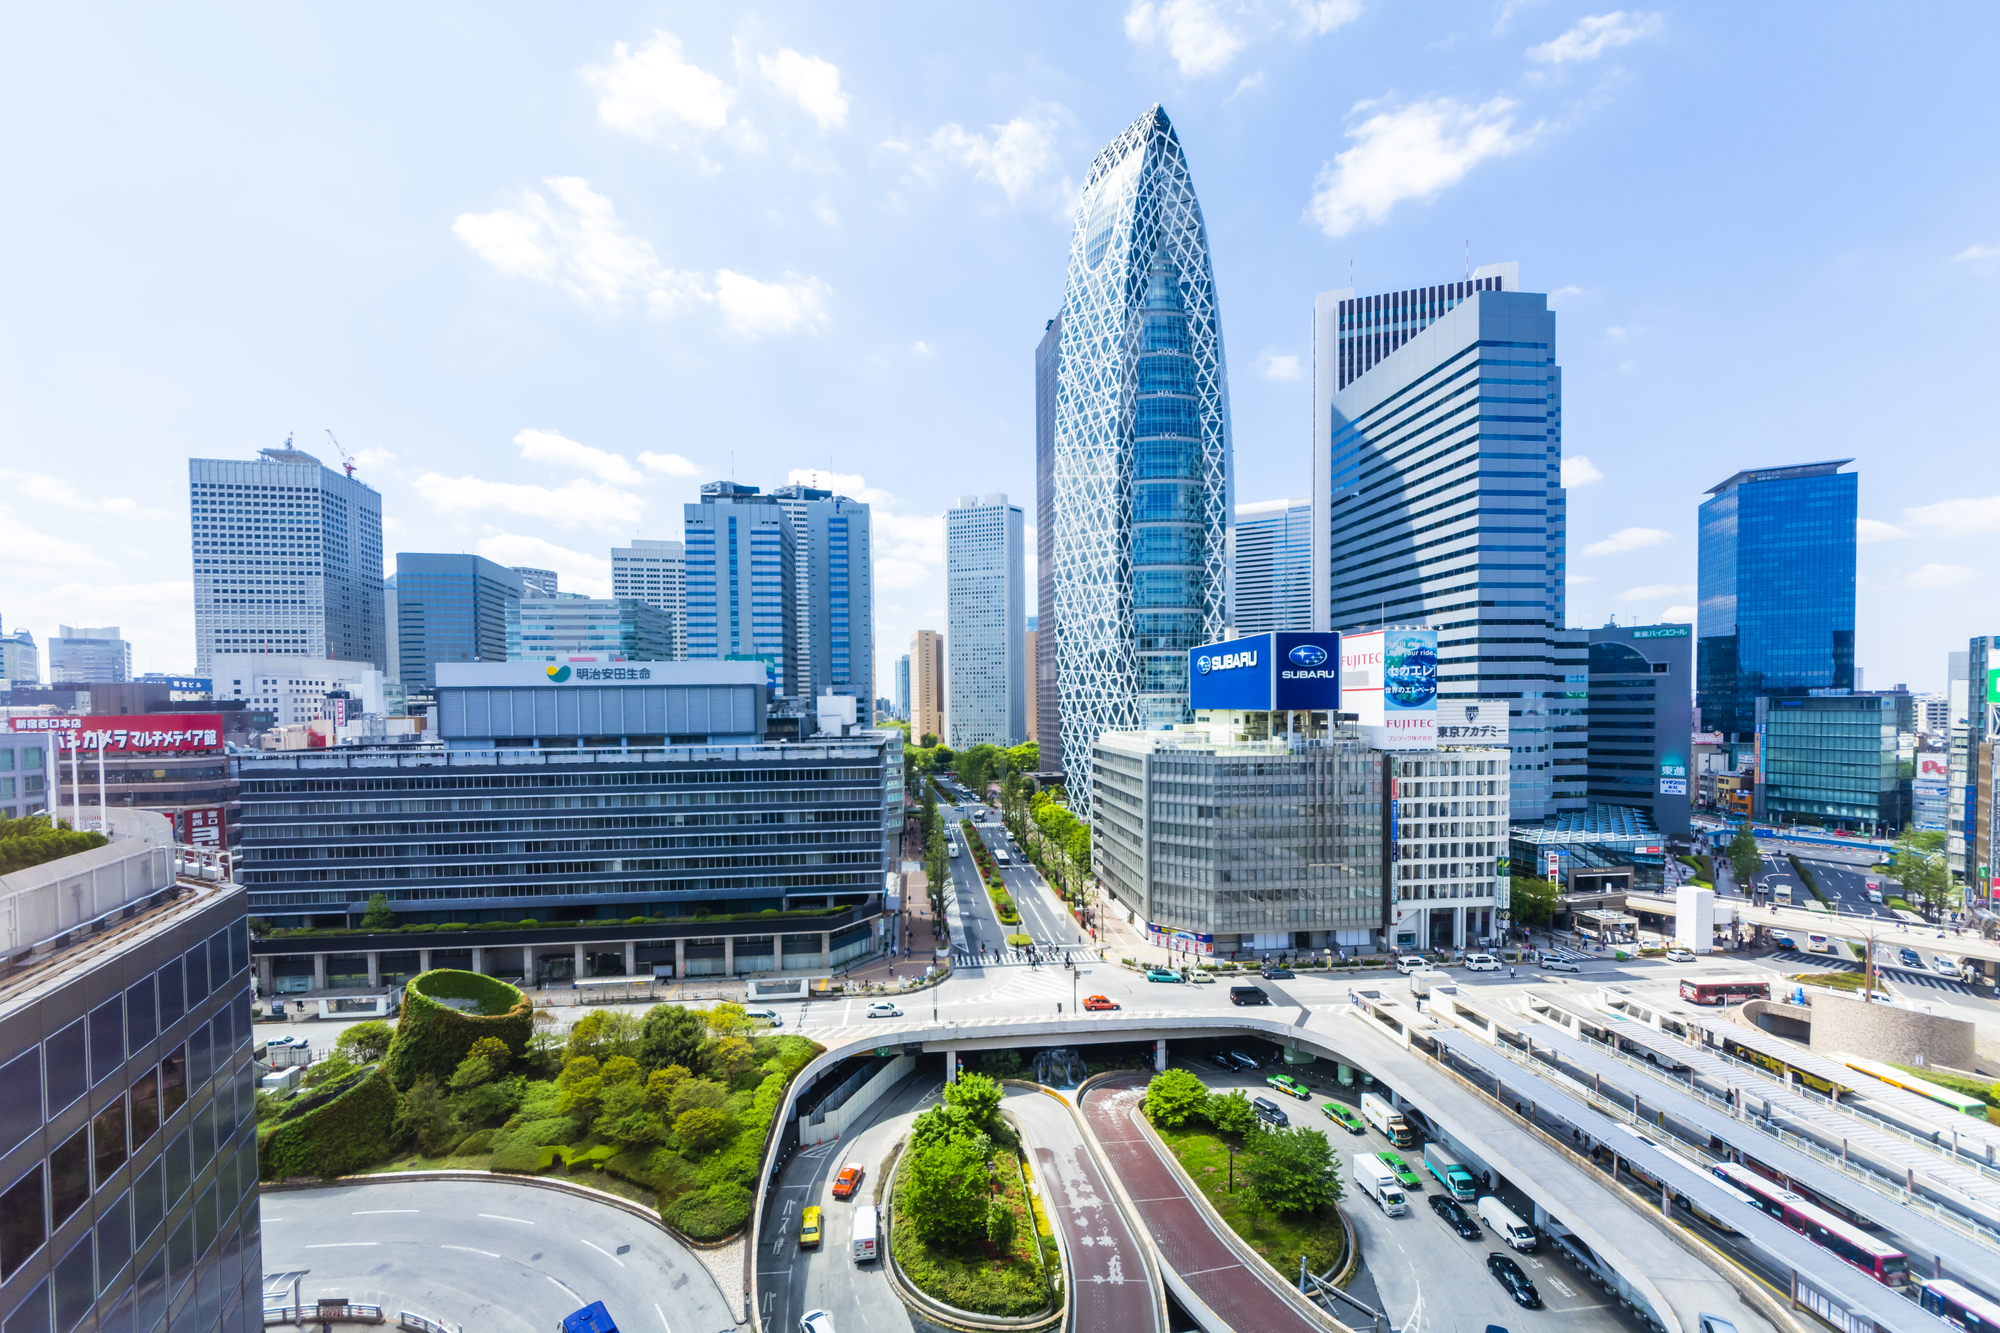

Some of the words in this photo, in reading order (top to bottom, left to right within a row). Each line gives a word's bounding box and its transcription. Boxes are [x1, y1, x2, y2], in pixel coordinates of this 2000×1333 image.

[1157, 348, 1179, 356] MODE
[1634, 628, 1688, 638] 東進ハイスクール
[1212, 650, 1257, 670] SUBARU
[1342, 652, 1383, 670] FUJITEC
[576, 667, 651, 680] 明治安田生命
[1282, 670, 1335, 679] SUBARU
[15, 718, 82, 729] 新宿西口本店
[1386, 719, 1435, 731] FUJITEC
[1437, 725, 1507, 738] 東京アカデミー
[1661, 765, 1685, 776] 東進
